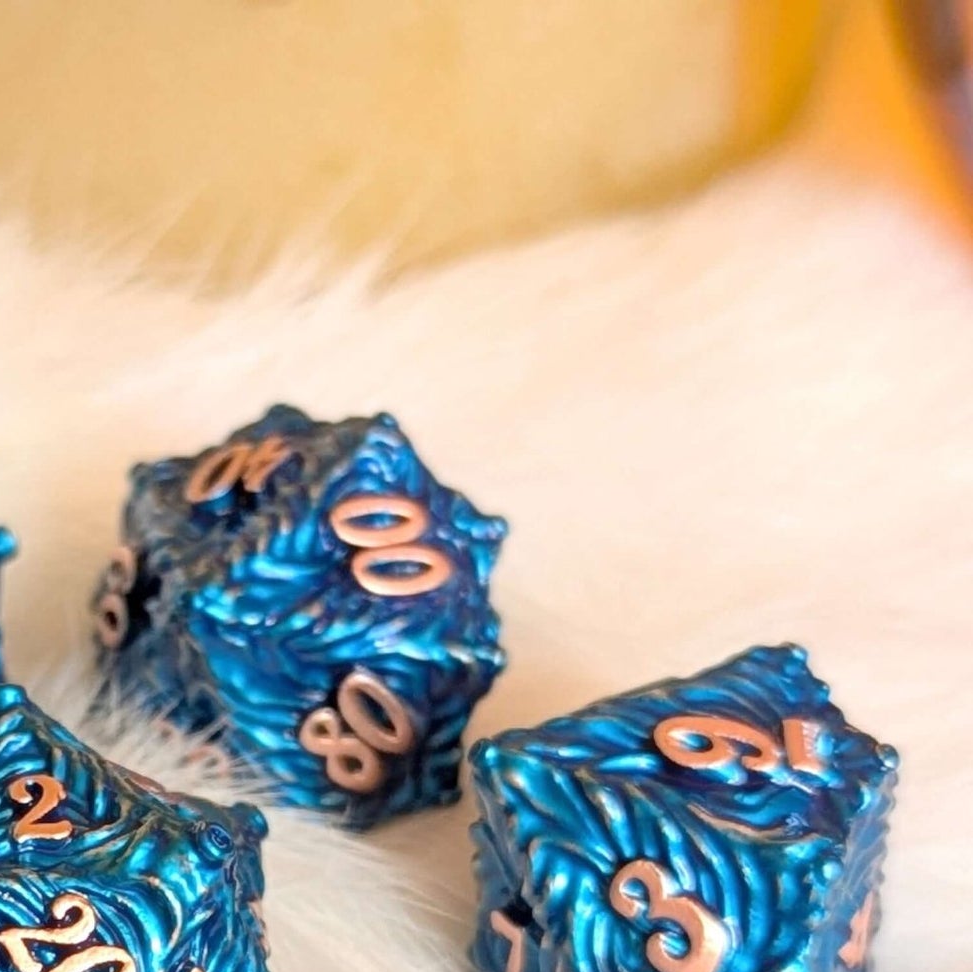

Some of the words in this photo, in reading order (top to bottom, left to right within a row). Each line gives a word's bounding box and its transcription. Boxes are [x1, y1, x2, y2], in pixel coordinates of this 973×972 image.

[331, 494, 452, 596] 00
[300, 672, 413, 793] 80
[7, 775, 73, 843] 2
